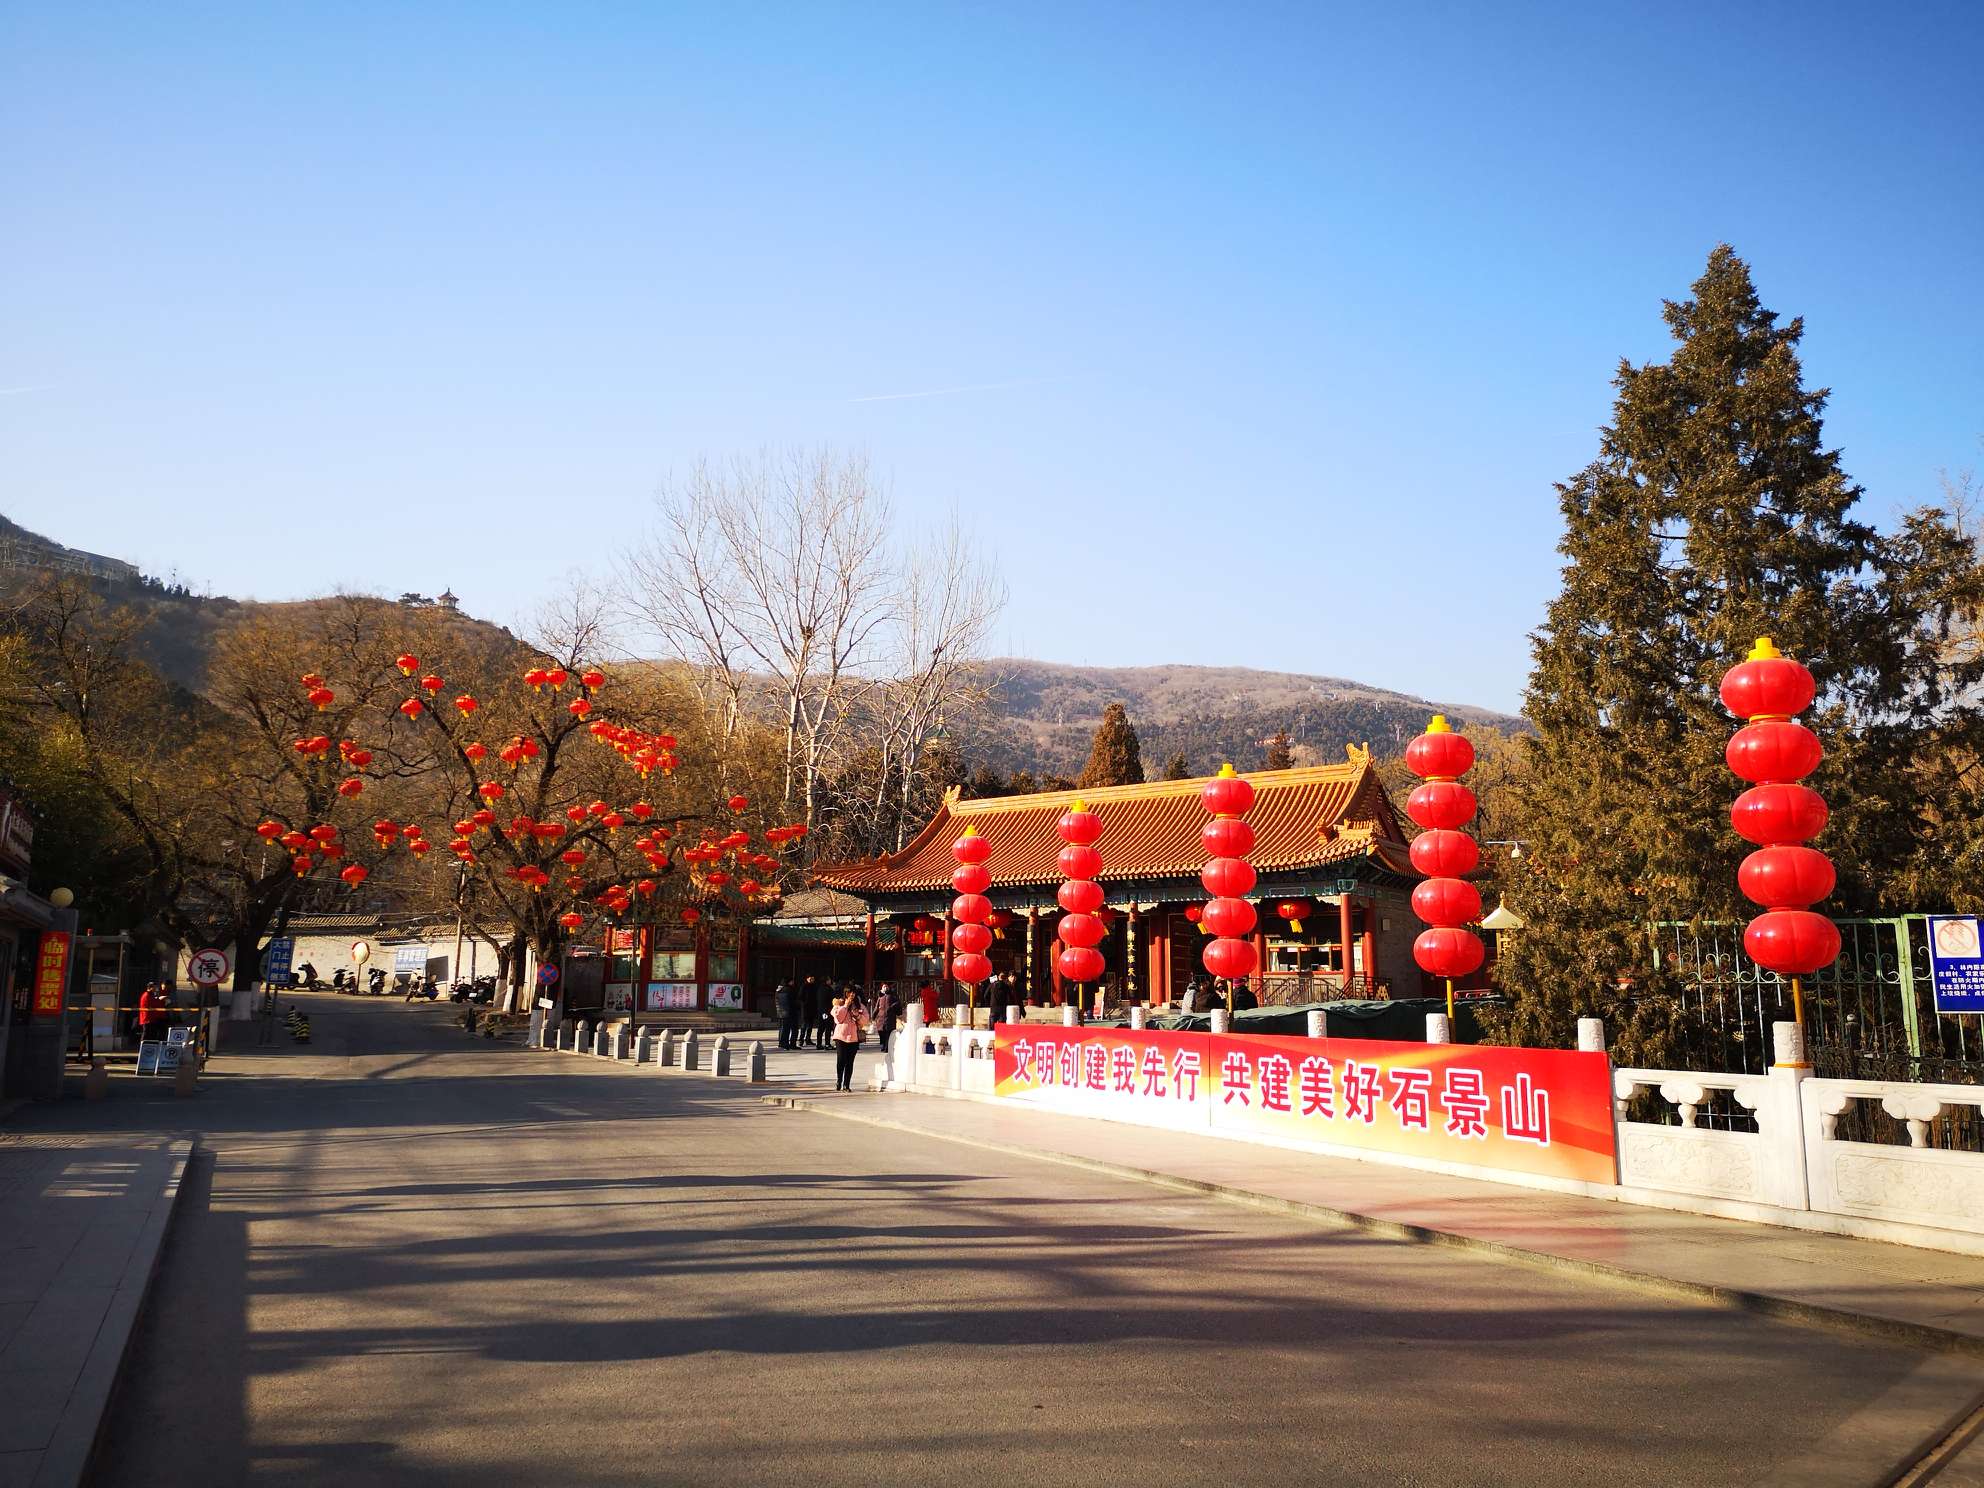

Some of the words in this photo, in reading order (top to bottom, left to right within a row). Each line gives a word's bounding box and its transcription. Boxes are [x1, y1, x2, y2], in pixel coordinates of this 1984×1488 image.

[197, 958, 220, 978] 停
[1013, 1039, 1201, 1103] 文明创建我先行
[1222, 1052, 1552, 1148] 共建美好石景山
